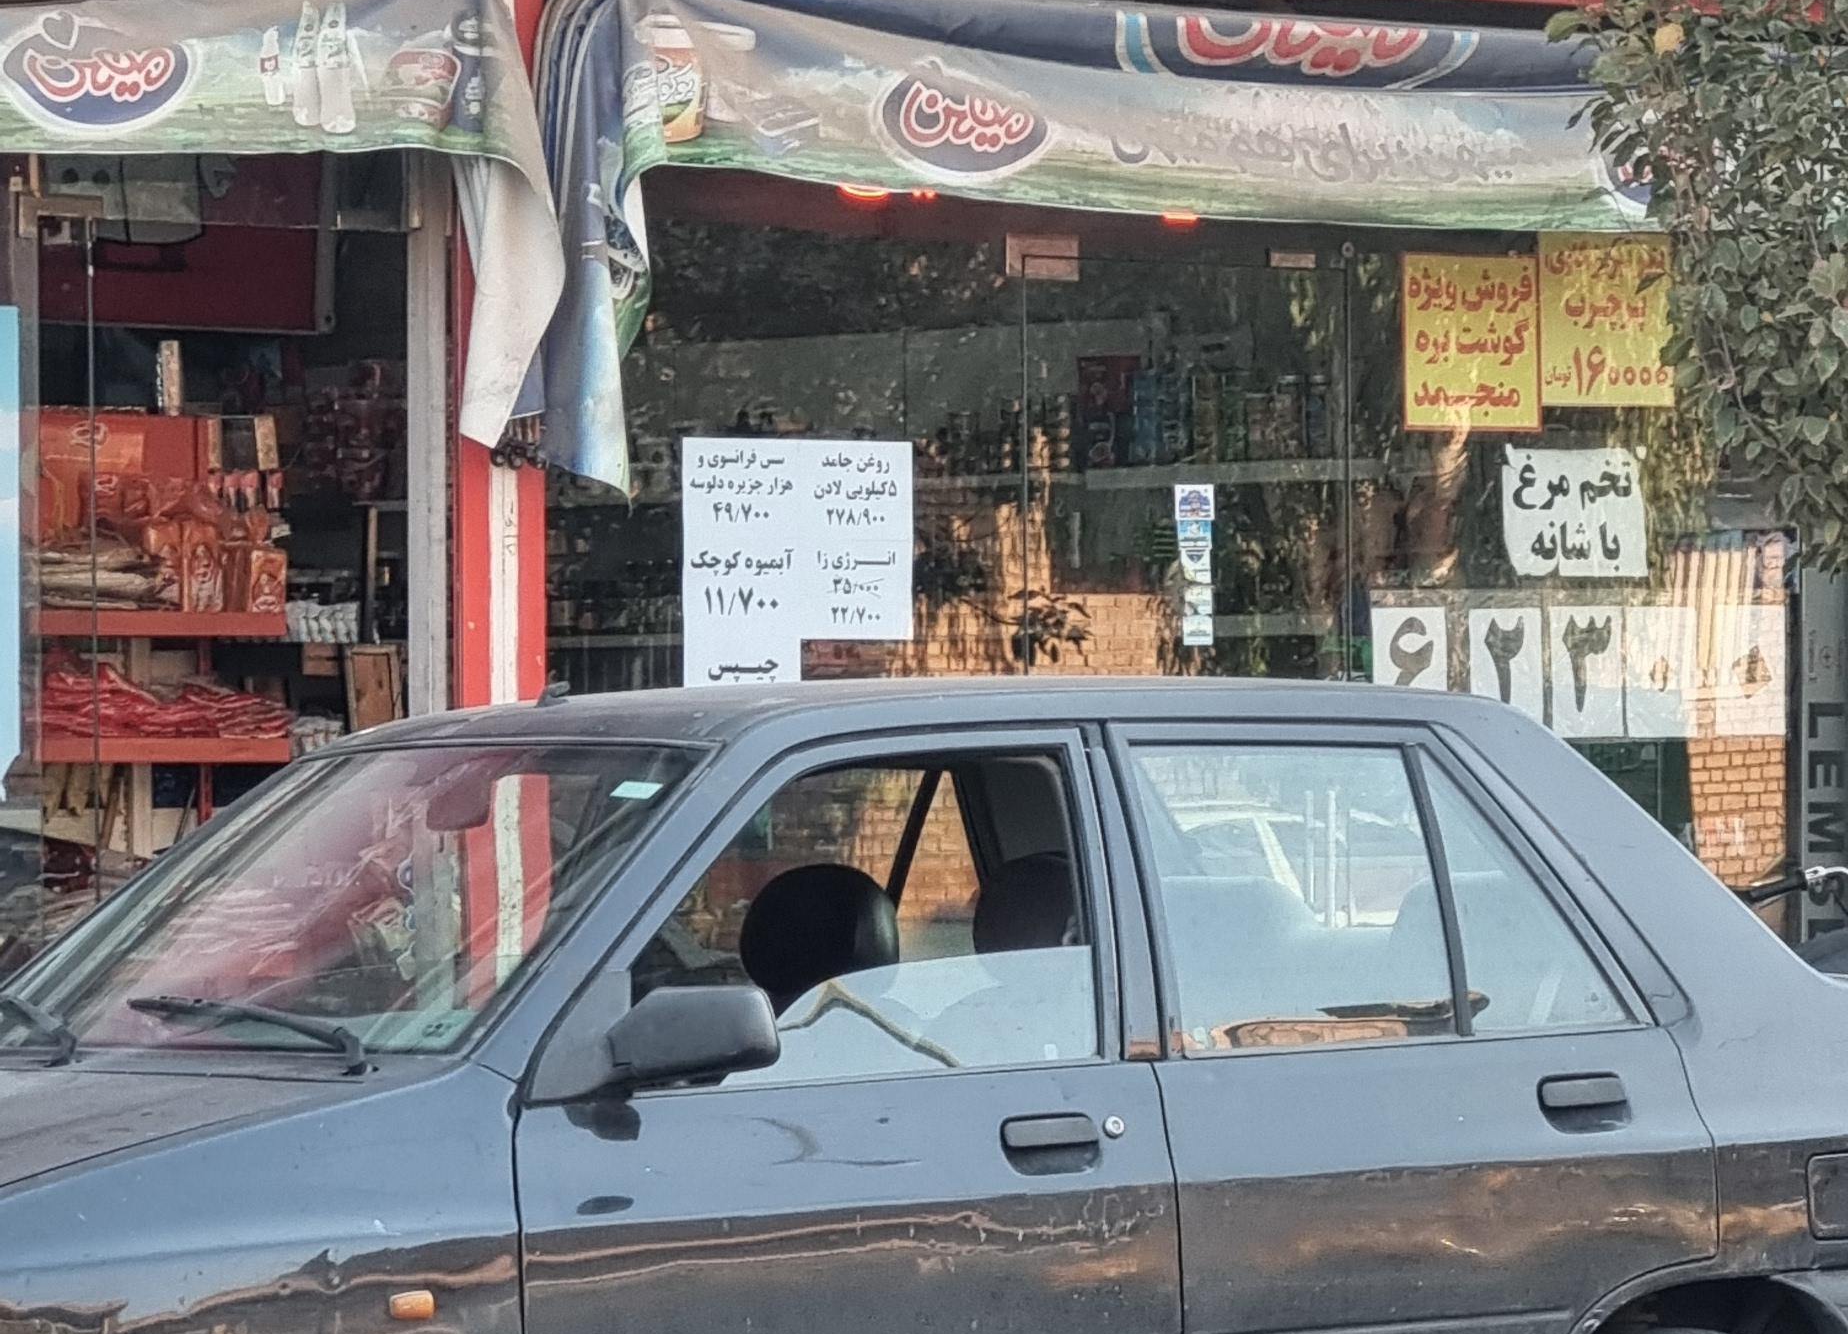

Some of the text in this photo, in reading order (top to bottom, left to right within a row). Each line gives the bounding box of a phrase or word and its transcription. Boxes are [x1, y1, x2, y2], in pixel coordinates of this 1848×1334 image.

[899, 78, 1036, 153] میهن
[1407, 265, 1533, 314] فروش ویژه
[1415, 317, 1530, 366] گوشت بره
[1545, 366, 1572, 389] تومان
[1414, 380, 1521, 417] منجمد
[697, 448, 786, 469] سس فرانسوی و
[856, 453, 891, 473] روغن
[728, 478, 763, 496] جزیره
[767, 477, 794, 496] هزار
[813, 480, 843, 499] لادن
[1512, 453, 1634, 510] تخم مرغ
[712, 500, 771, 524] ۴۹/۷۰۰
[825, 507, 886, 526] ۲۷۸/۹۰۰
[1530, 520, 1621, 573] با شانه
[689, 547, 795, 576] آبمیوه کوچک
[816, 550, 897, 571] انرژی زا
[703, 585, 780, 616] ۱۱/۷۰۰
[830, 605, 882, 625] ۲۲/۷۰۰
[707, 656, 780, 683] چیپس
